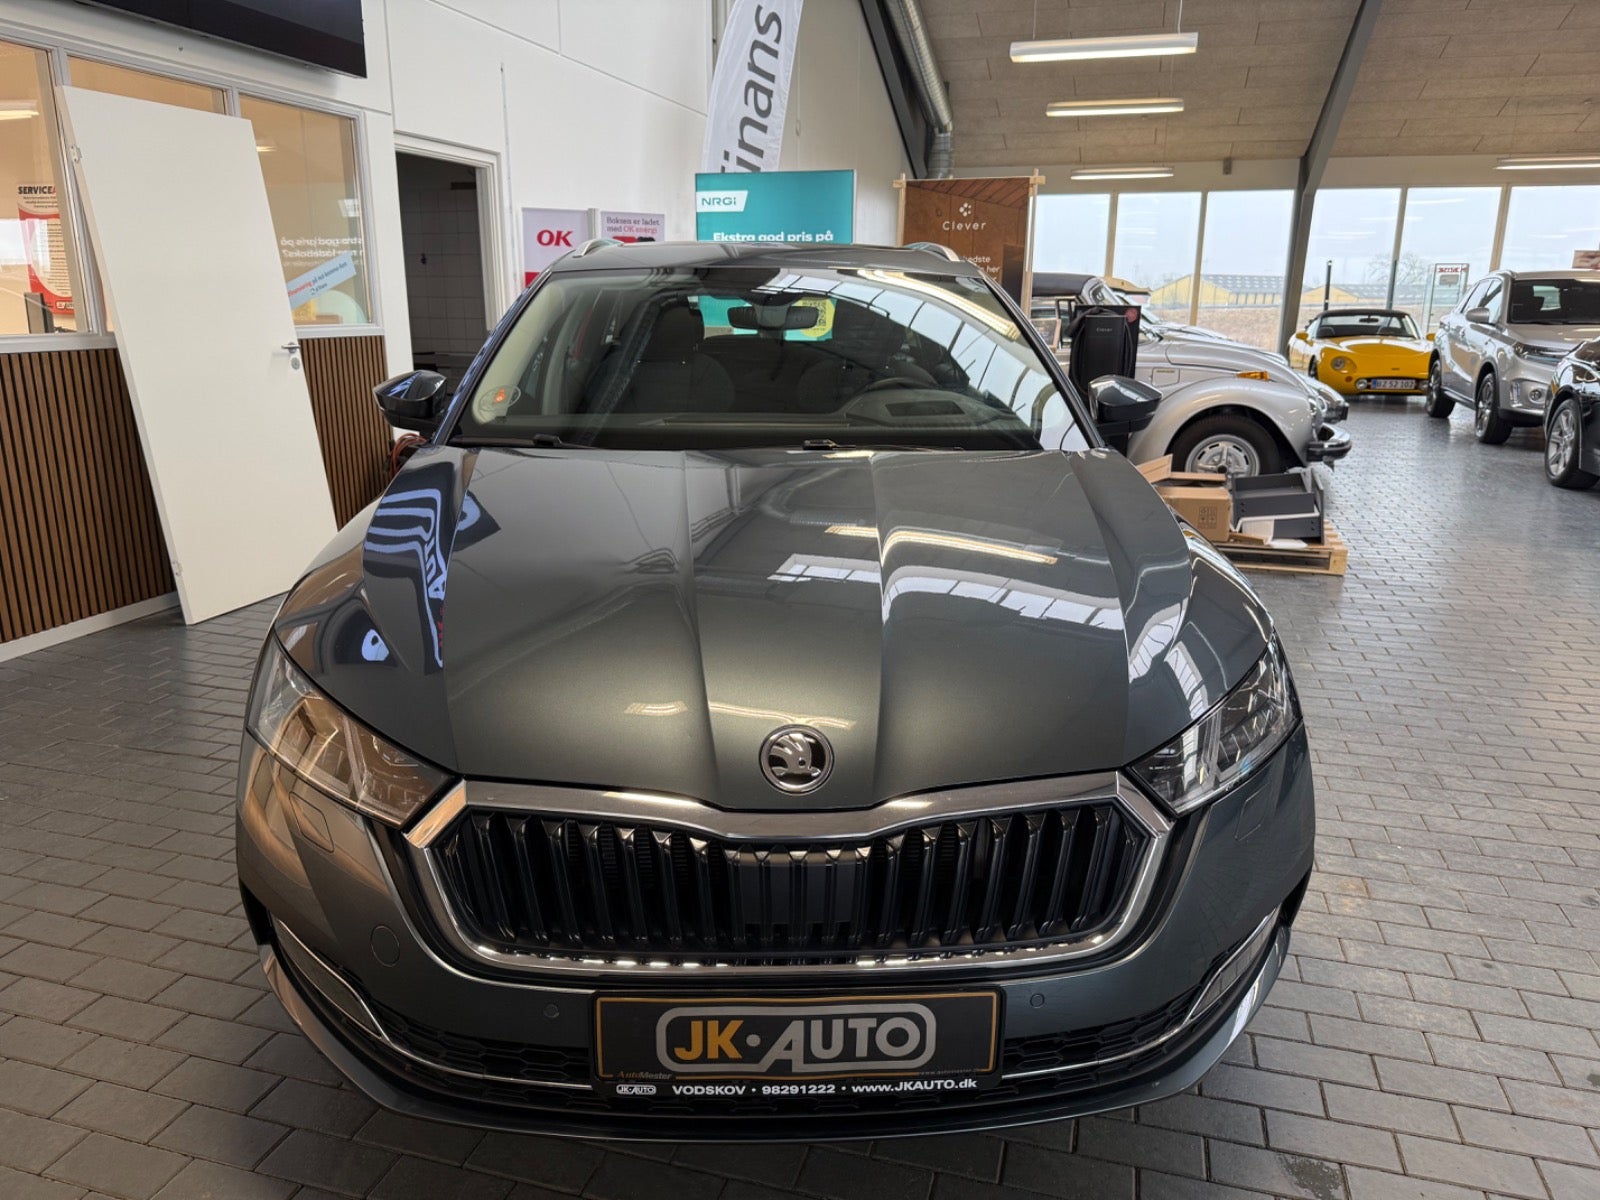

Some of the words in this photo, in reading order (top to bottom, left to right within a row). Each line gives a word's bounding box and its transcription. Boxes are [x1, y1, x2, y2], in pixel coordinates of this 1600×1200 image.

[721, 4, 782, 173] inans
[701, 196, 736, 206] NRGi
[606, 216, 631, 225] Boksen
[642, 217, 660, 226] ladet
[942, 221, 986, 231] Clever
[636, 226, 658, 234] energi
[536, 229, 573, 247] OK
[713, 231, 756, 242] Ekstra
[787, 231, 813, 242] pris
[815, 230, 834, 242] på
[962, 255, 991, 263] edste
[986, 265, 1000, 273] her
[672, 1085, 746, 1095] VODSKOV
[761, 1084, 836, 1095] 98291222
[851, 1078, 977, 1093] www.JKAUTO.dk
